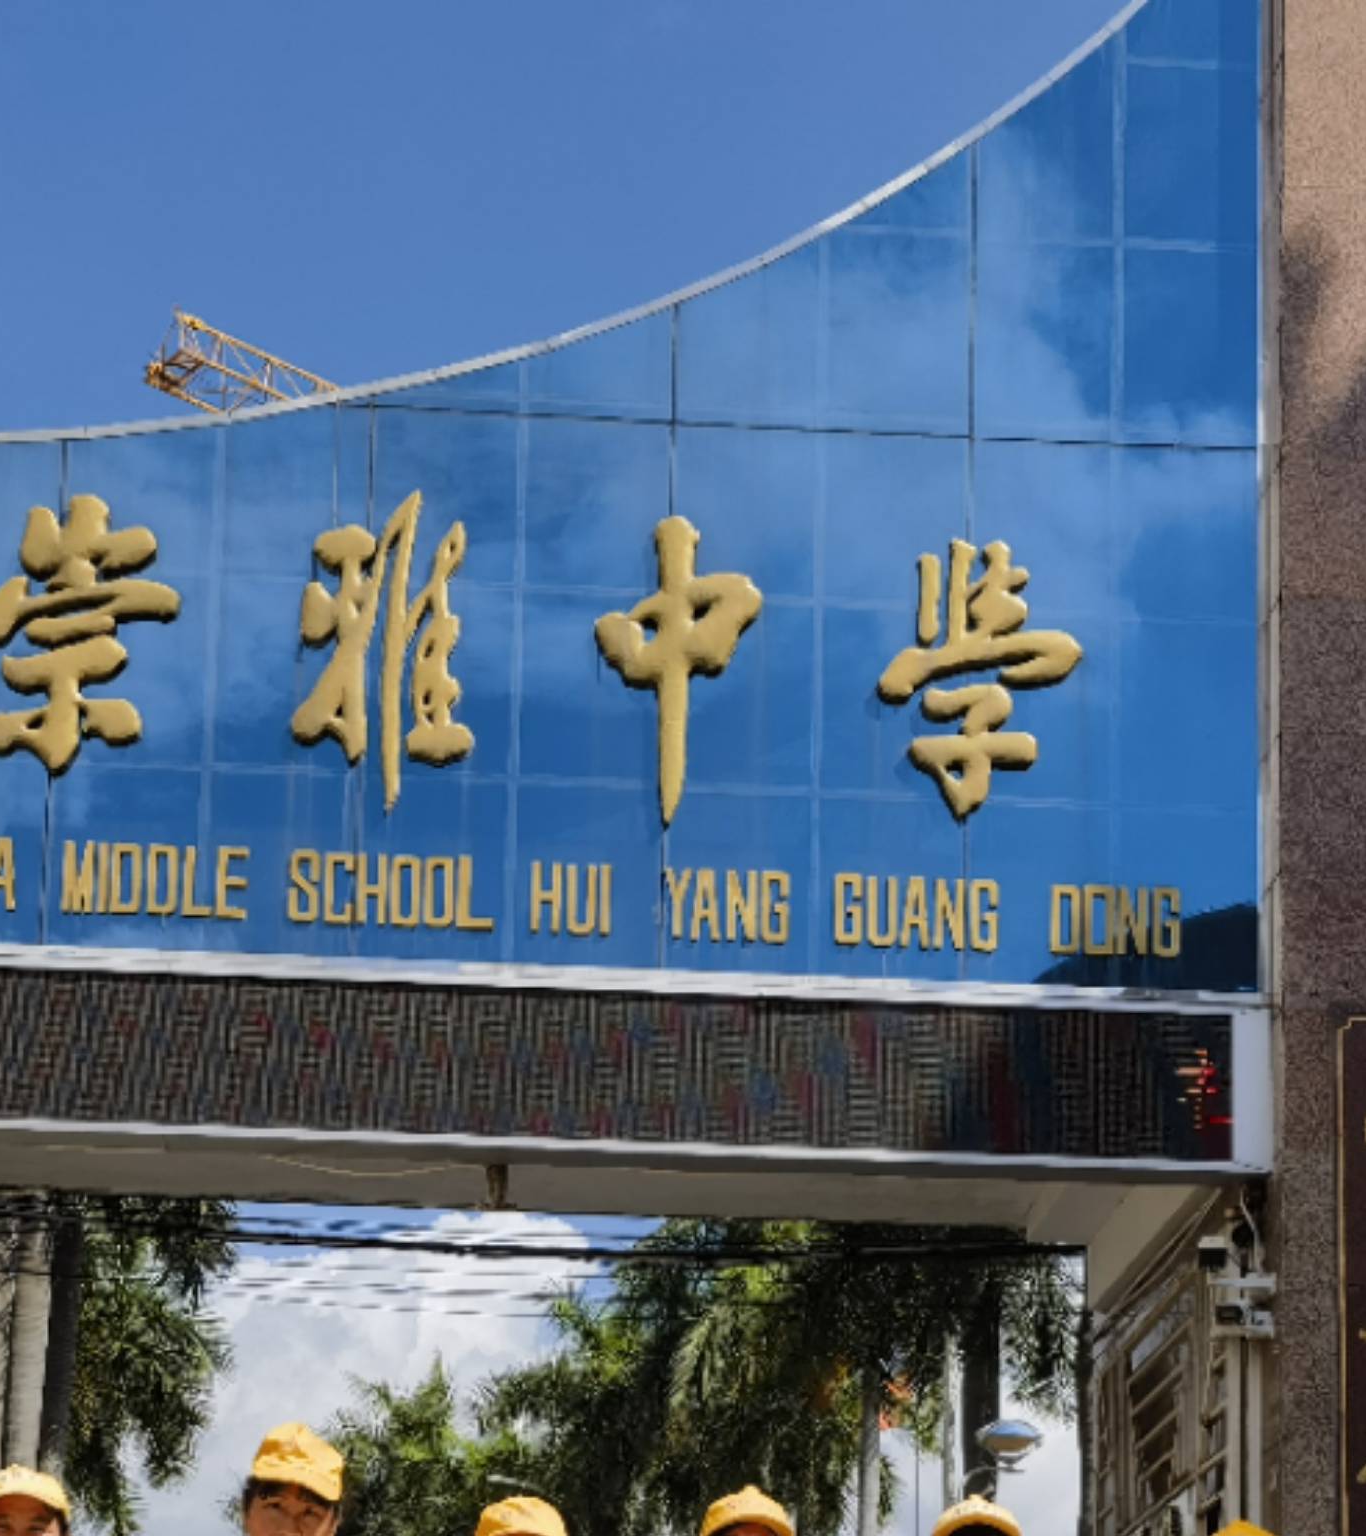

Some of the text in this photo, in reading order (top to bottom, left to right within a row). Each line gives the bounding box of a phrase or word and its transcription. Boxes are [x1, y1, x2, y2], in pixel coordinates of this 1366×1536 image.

[61, 839, 250, 919] MIDDLE
[286, 847, 494, 930] SCHOOL
[529, 860, 613, 936] HUI
[663, 867, 791, 944] YANG
[832, 872, 1000, 952] GUANG
[1049, 883, 1182, 958] DONG
